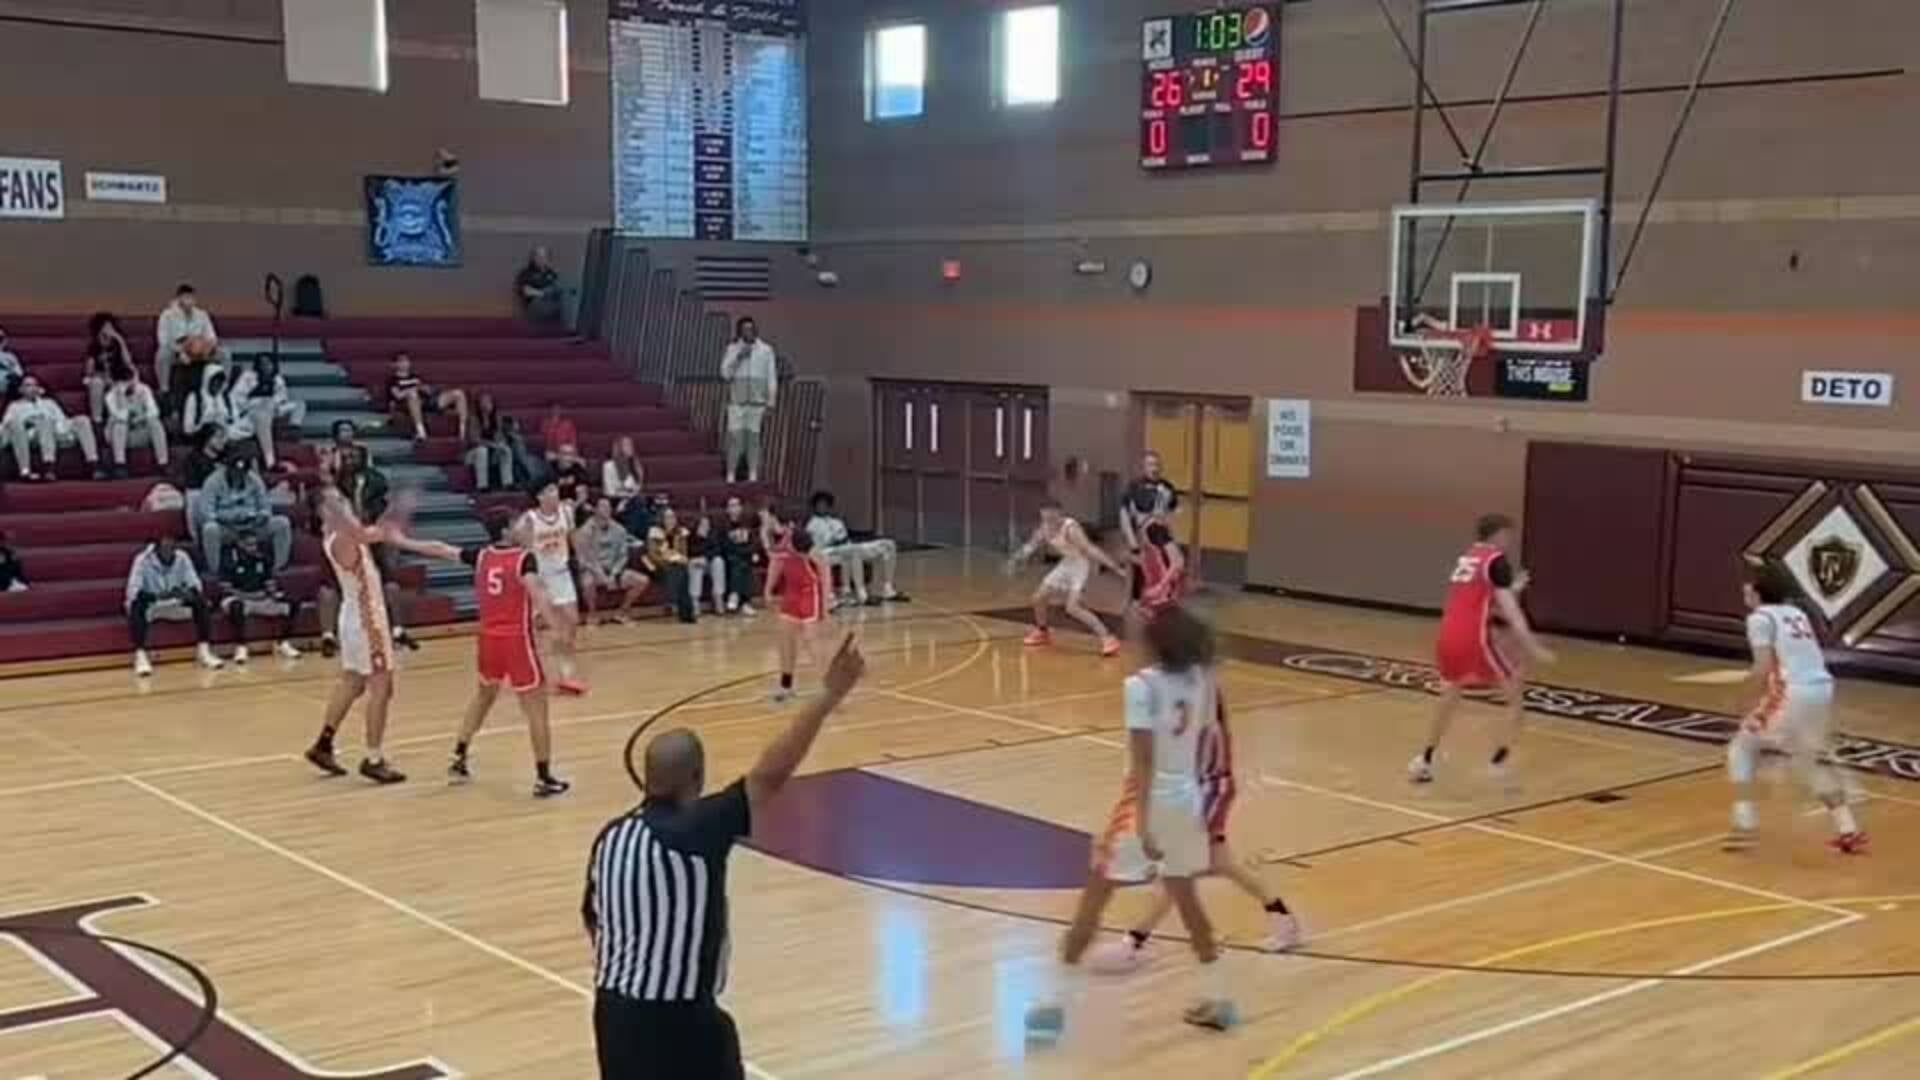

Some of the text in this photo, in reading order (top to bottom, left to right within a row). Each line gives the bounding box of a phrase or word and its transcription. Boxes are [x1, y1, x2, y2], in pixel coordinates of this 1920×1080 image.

[1196, 13, 1242, 49] 1:03
[1152, 71, 1181, 107] 26
[1237, 61, 1270, 98] 29
[1150, 120, 1167, 154] 0
[1252, 112, 1270, 147] 0
[0, 169, 59, 211] FANS
[1811, 377, 1882, 399] DETO
[486, 567, 504, 596] 5
